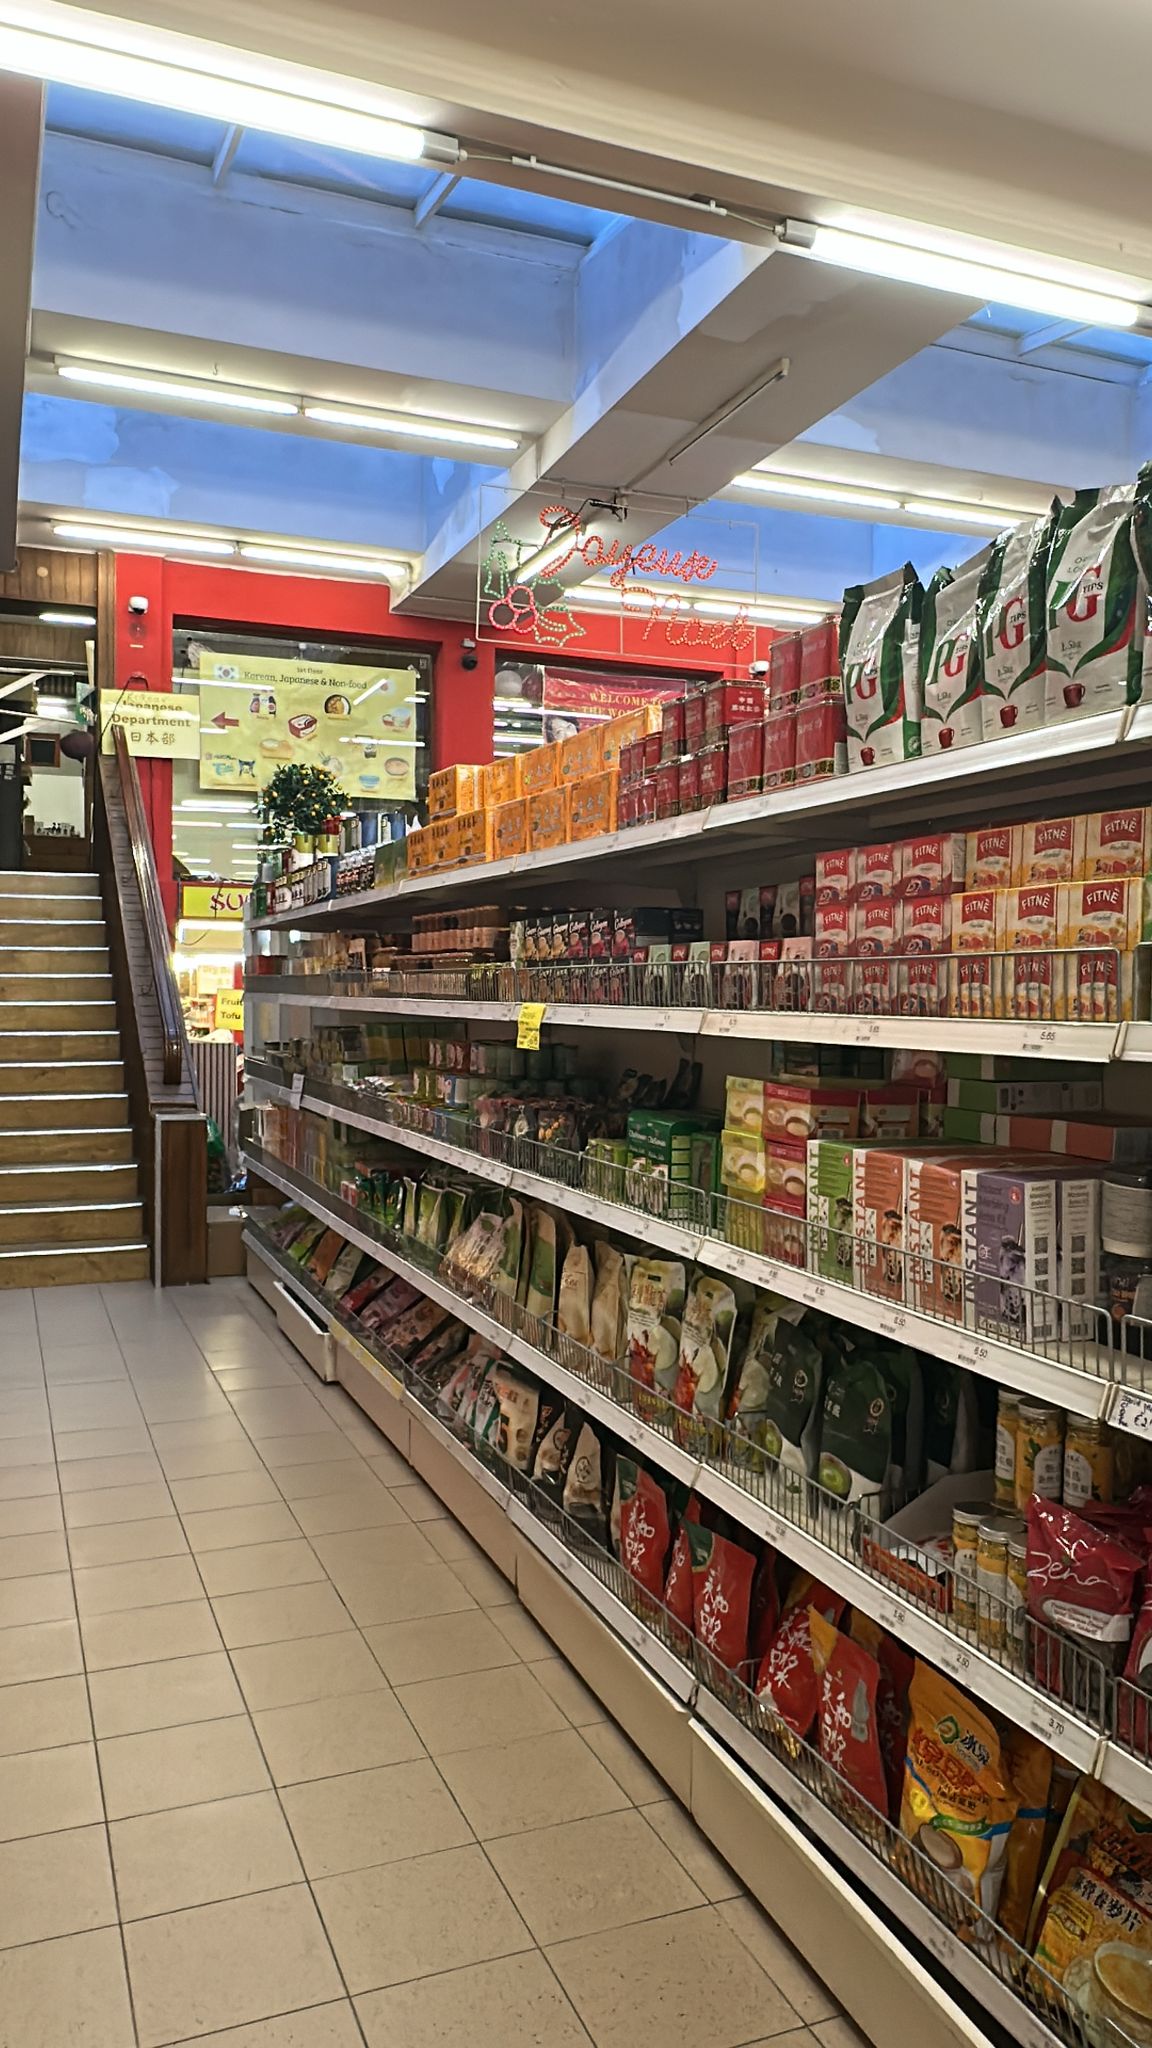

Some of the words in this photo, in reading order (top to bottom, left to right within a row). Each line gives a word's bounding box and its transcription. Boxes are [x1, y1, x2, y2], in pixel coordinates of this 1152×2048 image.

[539, 504, 719, 587] Joyeux
[1082, 581, 1104, 593] TIPS
[279, 674, 319, 687] Japanese
[320, 678, 327, 686] &
[329, 679, 368, 690] Non-food
[590, 692, 648, 707] WELCOME
[112, 713, 191, 727] Department
[131, 731, 175, 745] 日本部
[221, 1012, 241, 1020] Tofu
[809, 1149, 819, 1253] INSTANT
[855, 1158, 865, 1268] INSTANT
[909, 1169, 921, 1286] INSTANT
[965, 1180, 977, 1304] INSTANT
[956, 1653, 970, 1669] 2.50
[1048, 1718, 1065, 1736] 3.70
